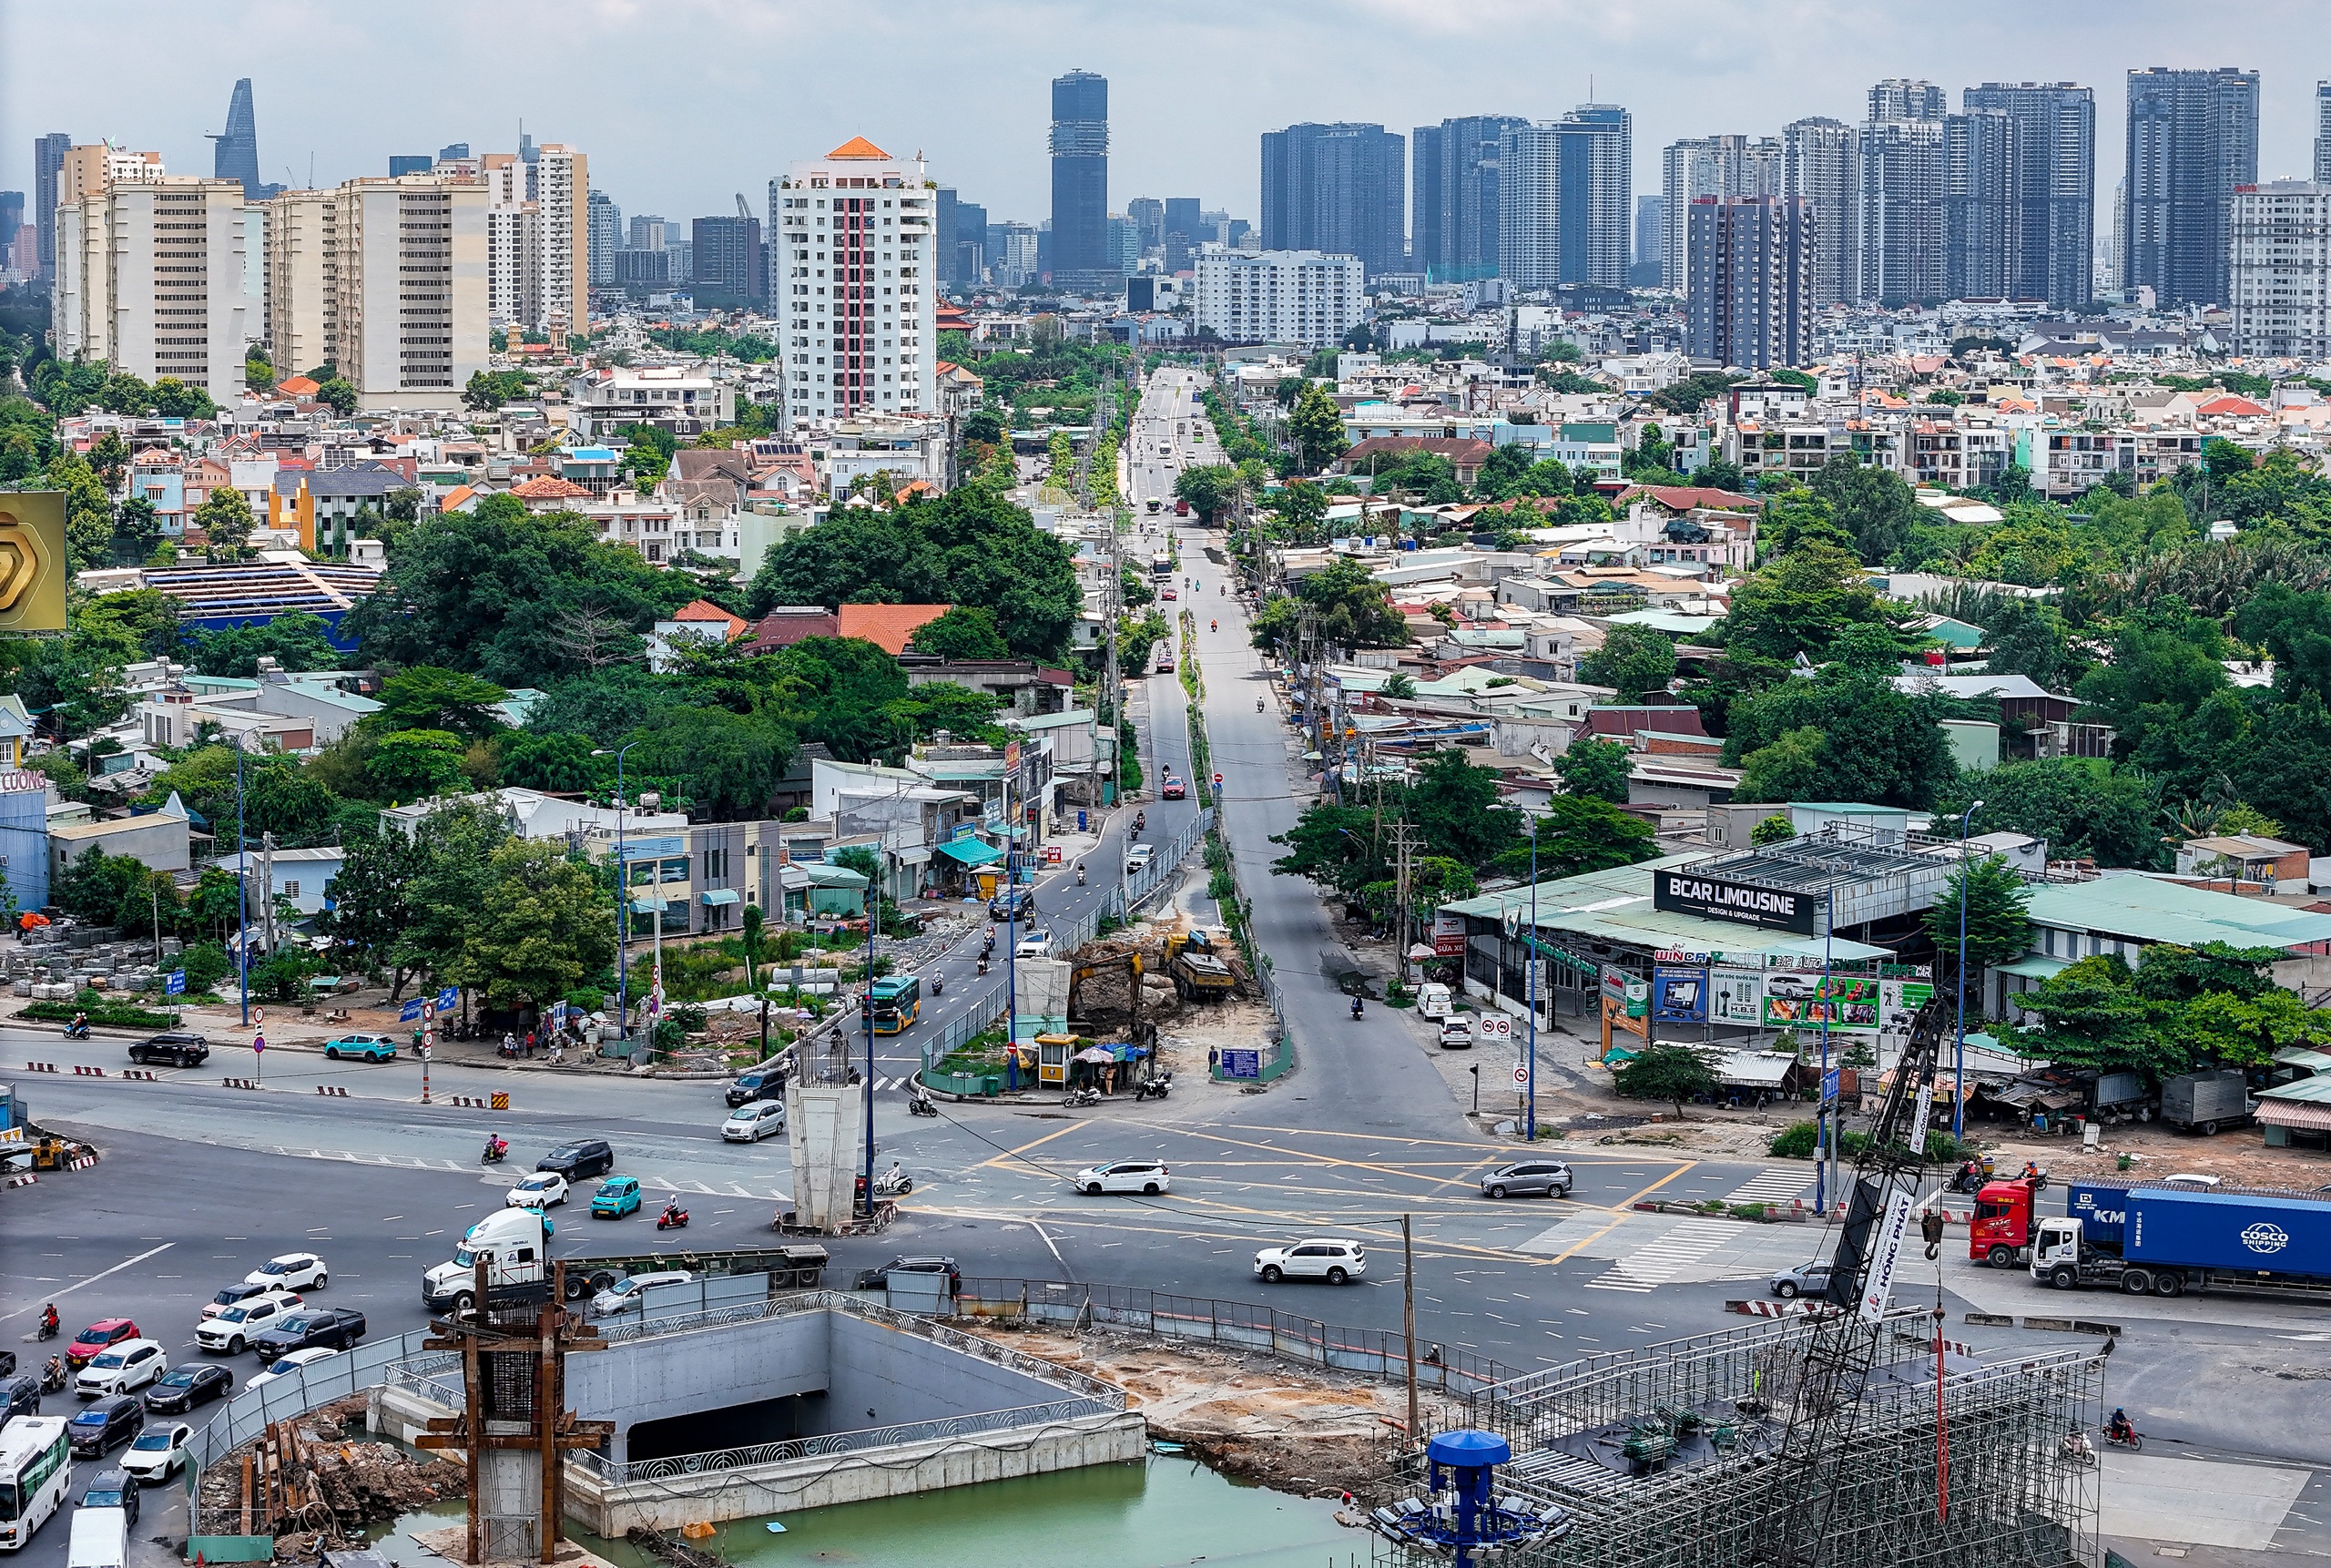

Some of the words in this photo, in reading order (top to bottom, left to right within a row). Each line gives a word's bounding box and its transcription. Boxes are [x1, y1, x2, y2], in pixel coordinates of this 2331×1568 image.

[1669, 877, 1713, 902] BCAR
[1715, 884, 1795, 916] LIMOUSINE
[1707, 906, 1728, 916] DESIGN
[1734, 911, 1760, 921] UPGRADE
[1437, 943, 1453, 952] SỬA
[1797, 956, 1822, 969] AUTO
[1879, 1240, 1898, 1288] HỒNG
[1892, 1196, 1909, 1240] PHÁT
[2240, 1230, 2289, 1242] COSCO
[2242, 1238, 2287, 1247] SHIPPING
